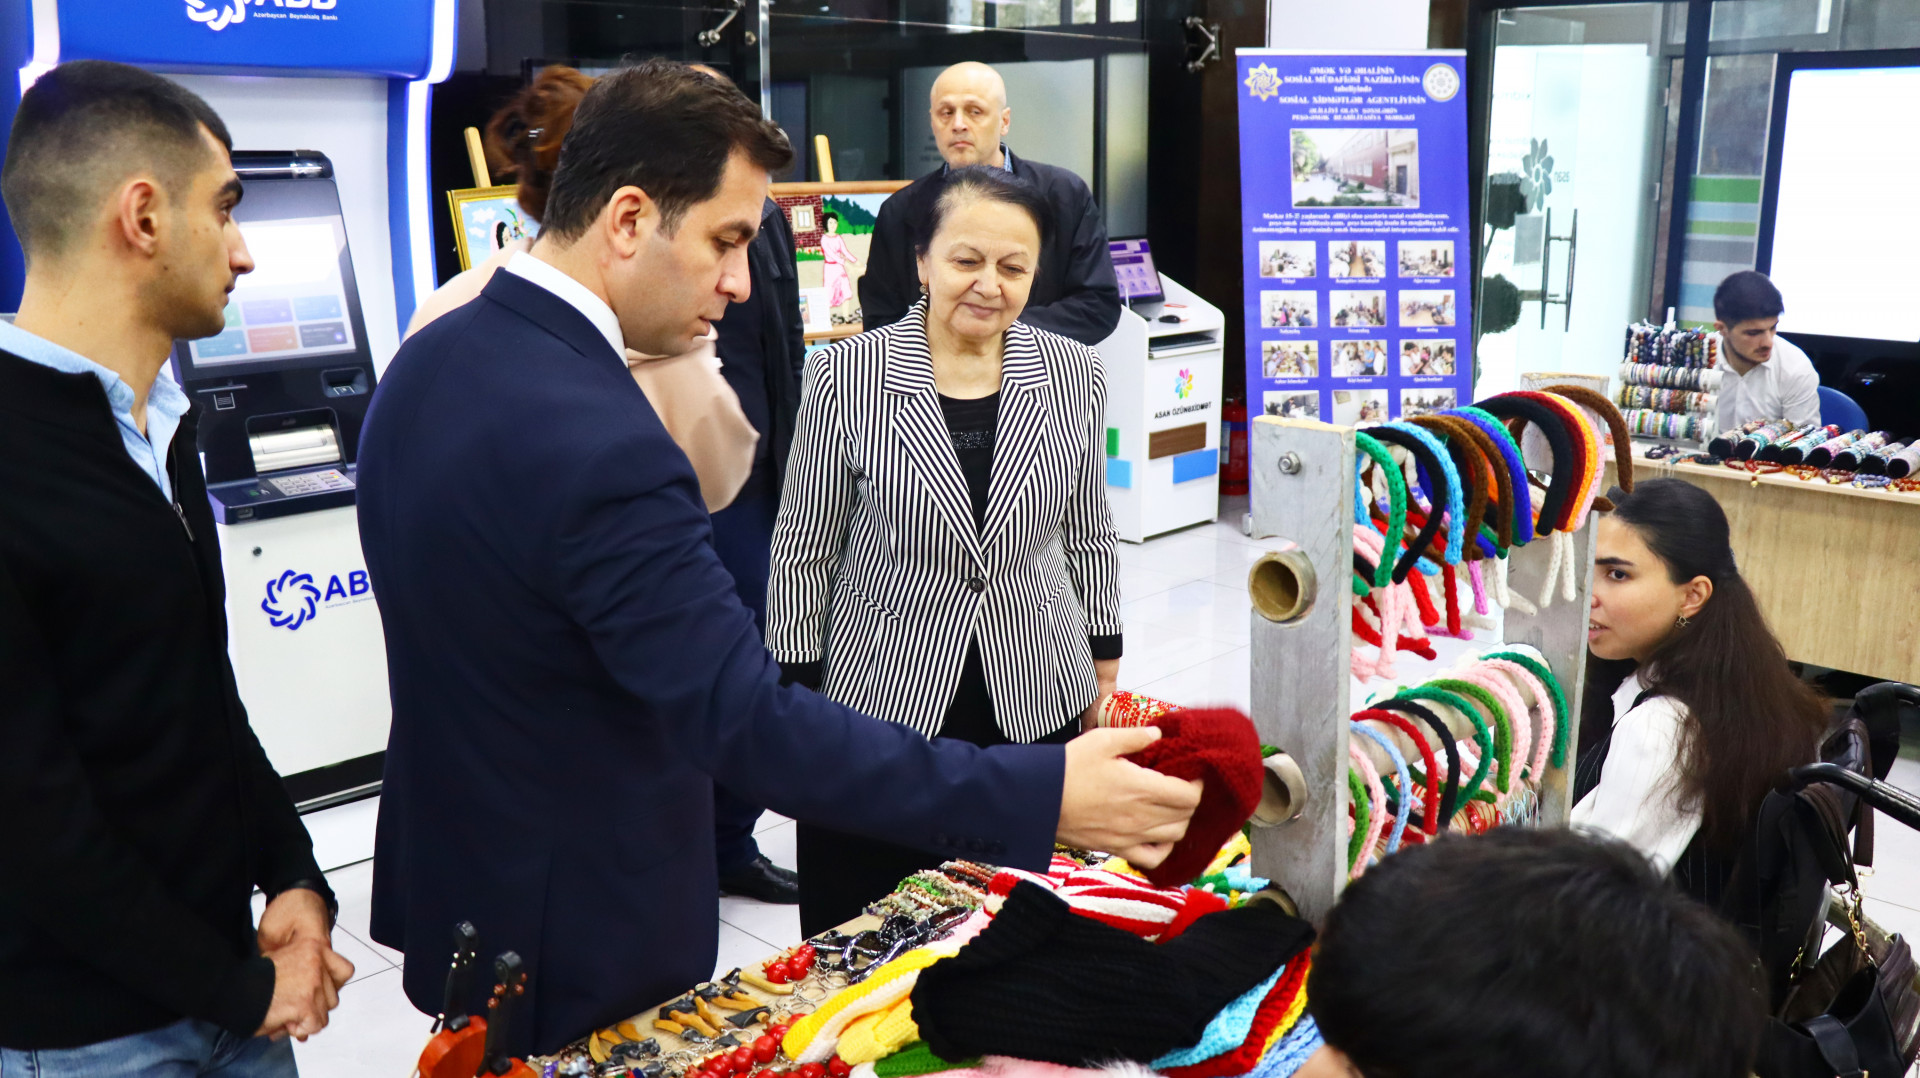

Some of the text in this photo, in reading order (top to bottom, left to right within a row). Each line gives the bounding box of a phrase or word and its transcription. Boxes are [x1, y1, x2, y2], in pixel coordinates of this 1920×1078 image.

[1309, 67, 1336, 75] ƏMƏK
[1338, 67, 1351, 75] VƏ
[1284, 75, 1314, 84] SOSİAL
[1279, 95, 1310, 104] SOSİAL
[1154, 410, 1171, 419] ASAN
[324, 570, 370, 602] AB
